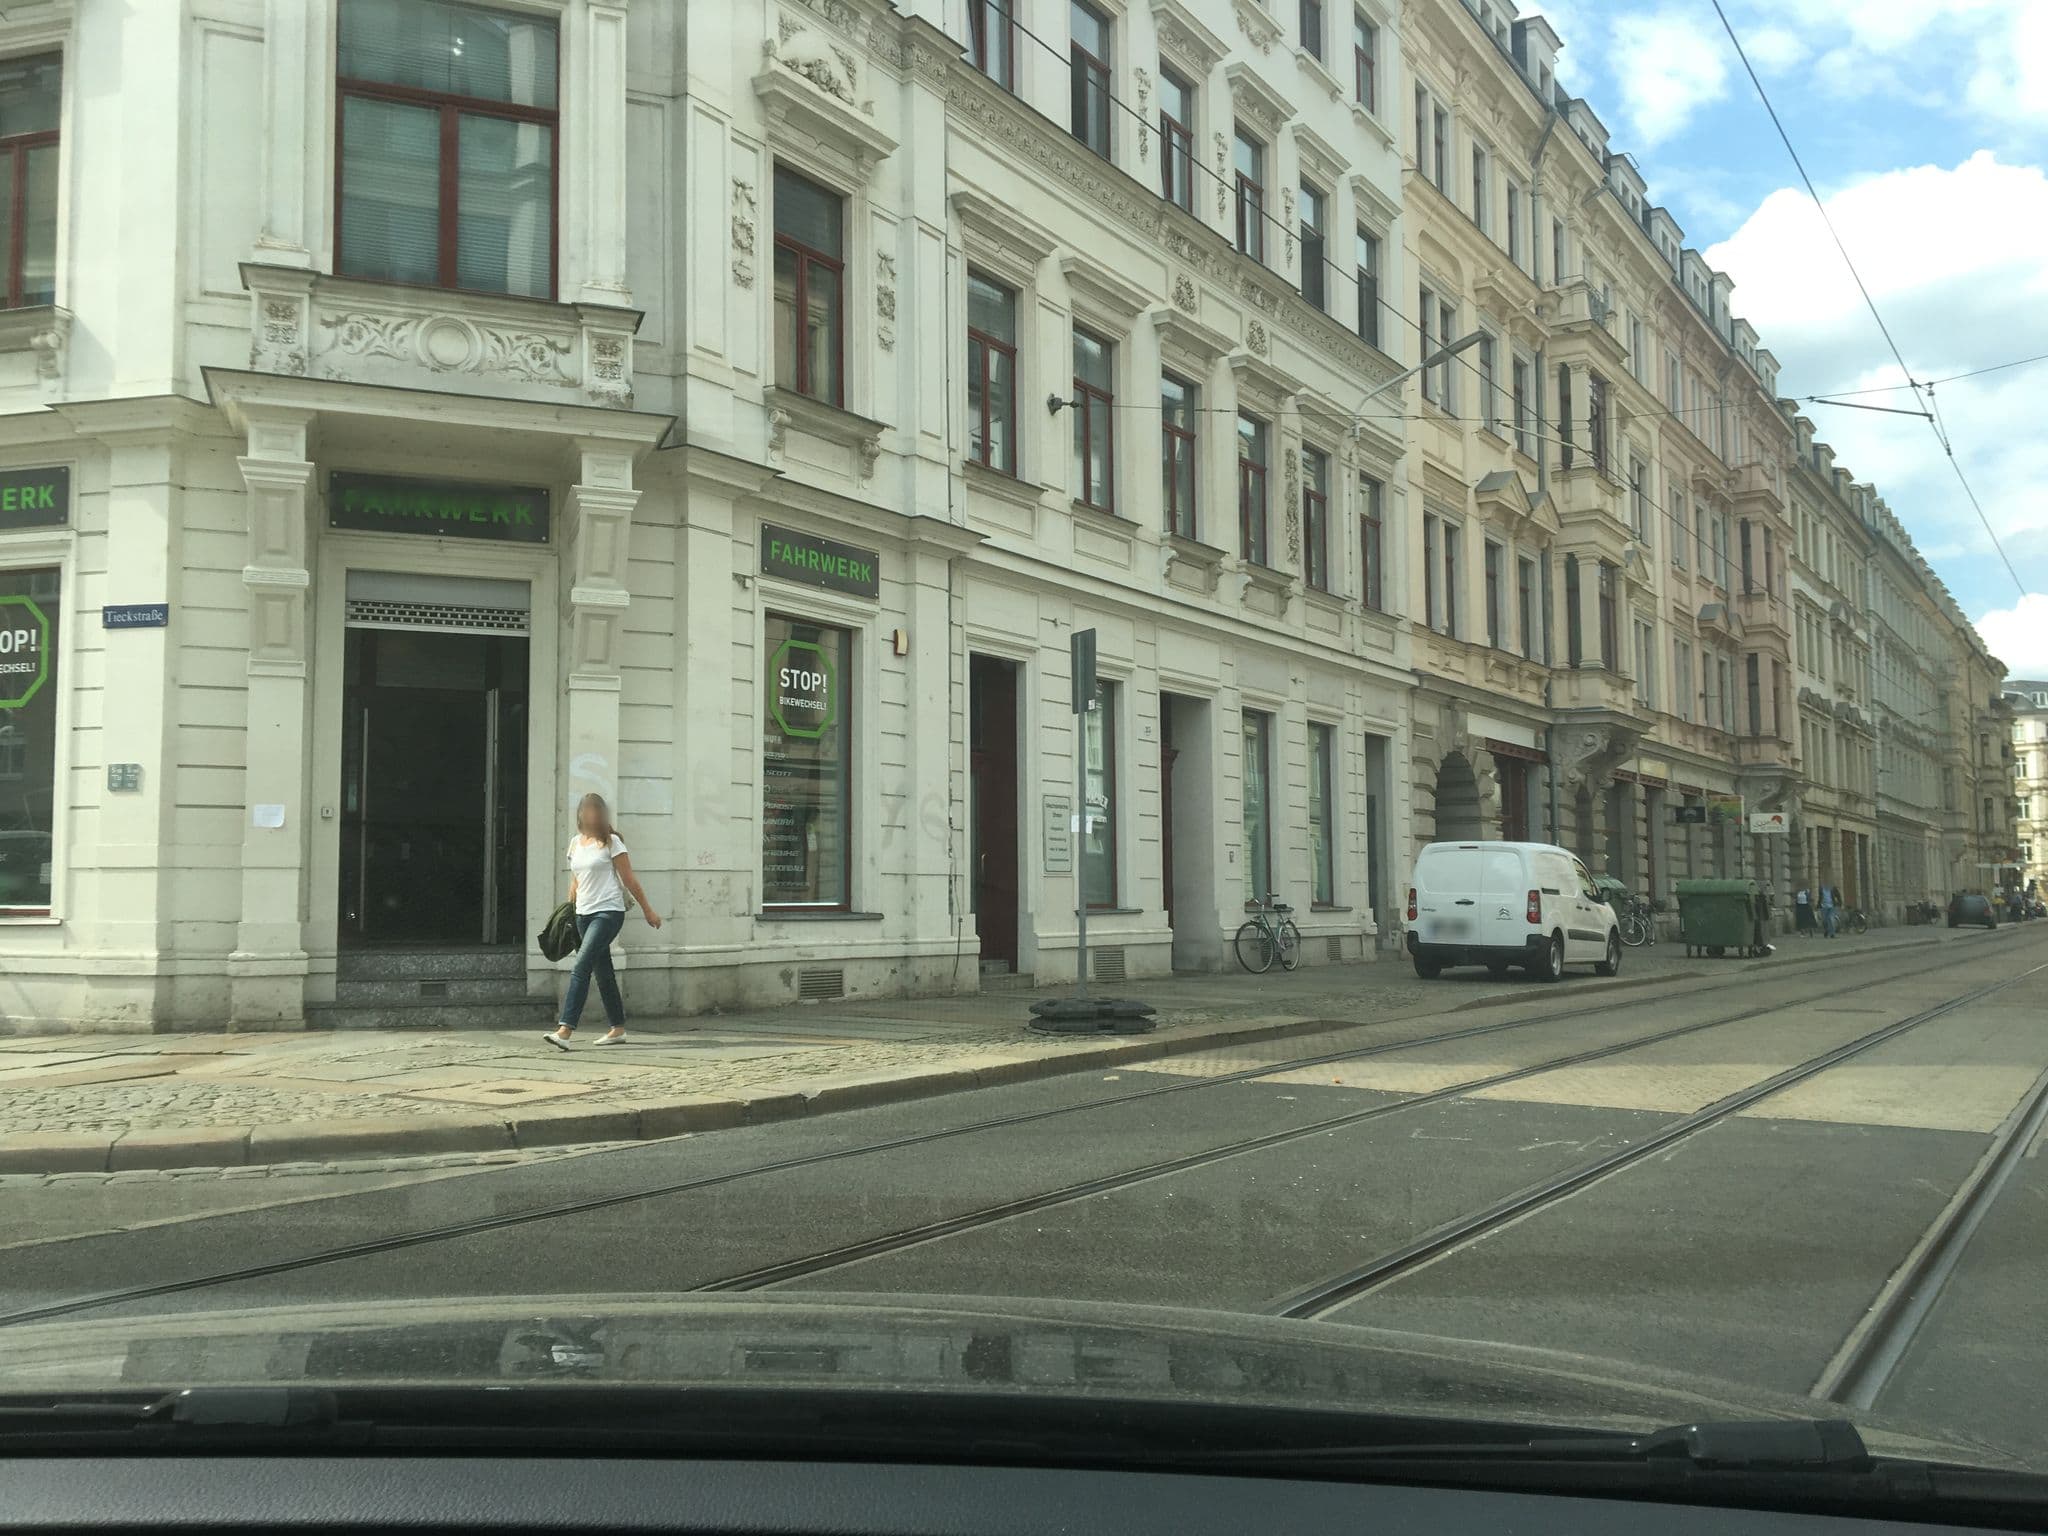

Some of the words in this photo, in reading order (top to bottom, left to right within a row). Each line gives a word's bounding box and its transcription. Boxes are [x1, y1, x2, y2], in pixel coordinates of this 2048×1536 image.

[770, 540, 872, 583] FAHRWERK
[106, 609, 164, 623] Tieckstraße
[779, 667, 828, 694] STOP!
[779, 696, 828, 712] BIKEWECHSEL!
